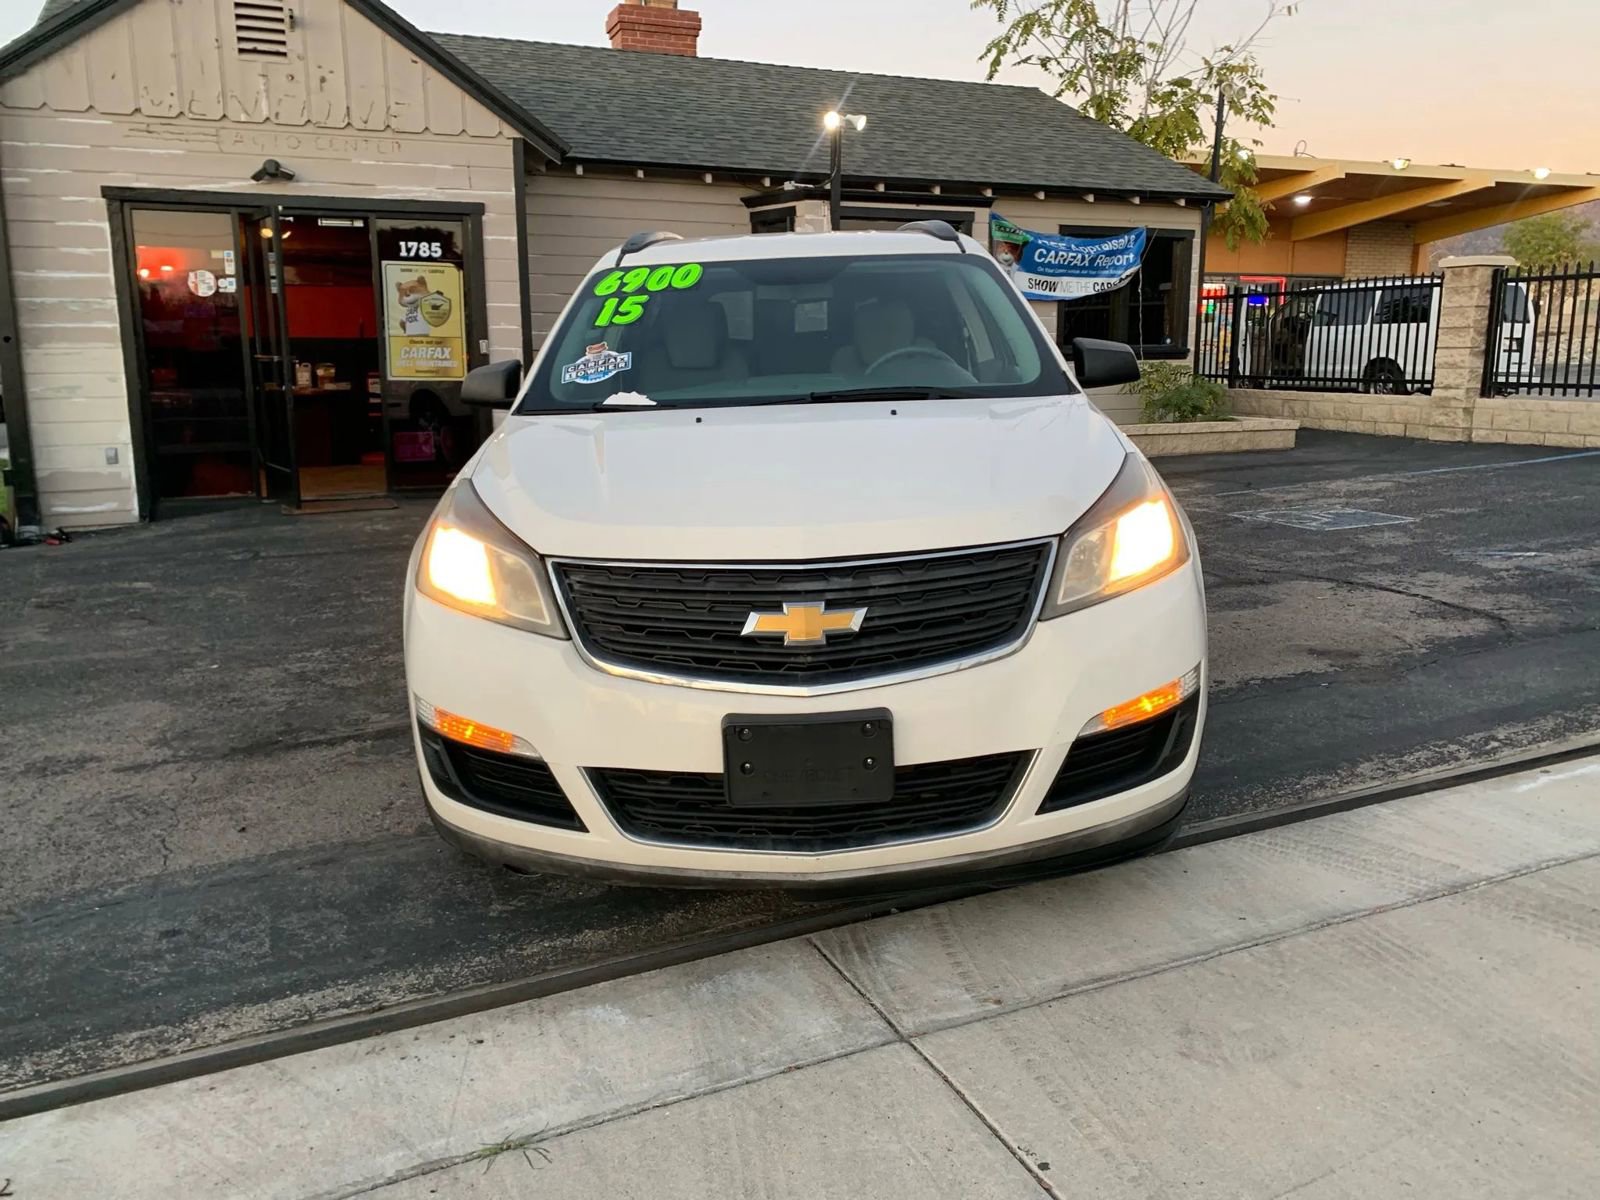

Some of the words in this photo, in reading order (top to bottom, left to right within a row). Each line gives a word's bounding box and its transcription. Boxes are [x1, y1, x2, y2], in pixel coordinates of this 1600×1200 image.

[399, 241, 442, 257] 1785
[1034, 248, 1093, 267] CARFAX
[1094, 252, 1135, 269] Report
[594, 263, 703, 296] 6900
[1028, 278, 1059, 293] SHOW
[1060, 280, 1073, 293] ME
[1074, 280, 1090, 294] THE
[594, 295, 649, 327] 15
[401, 347, 452, 359] CARFAX
[567, 356, 628, 372] CARFAX
[577, 361, 626, 377] OWNER
